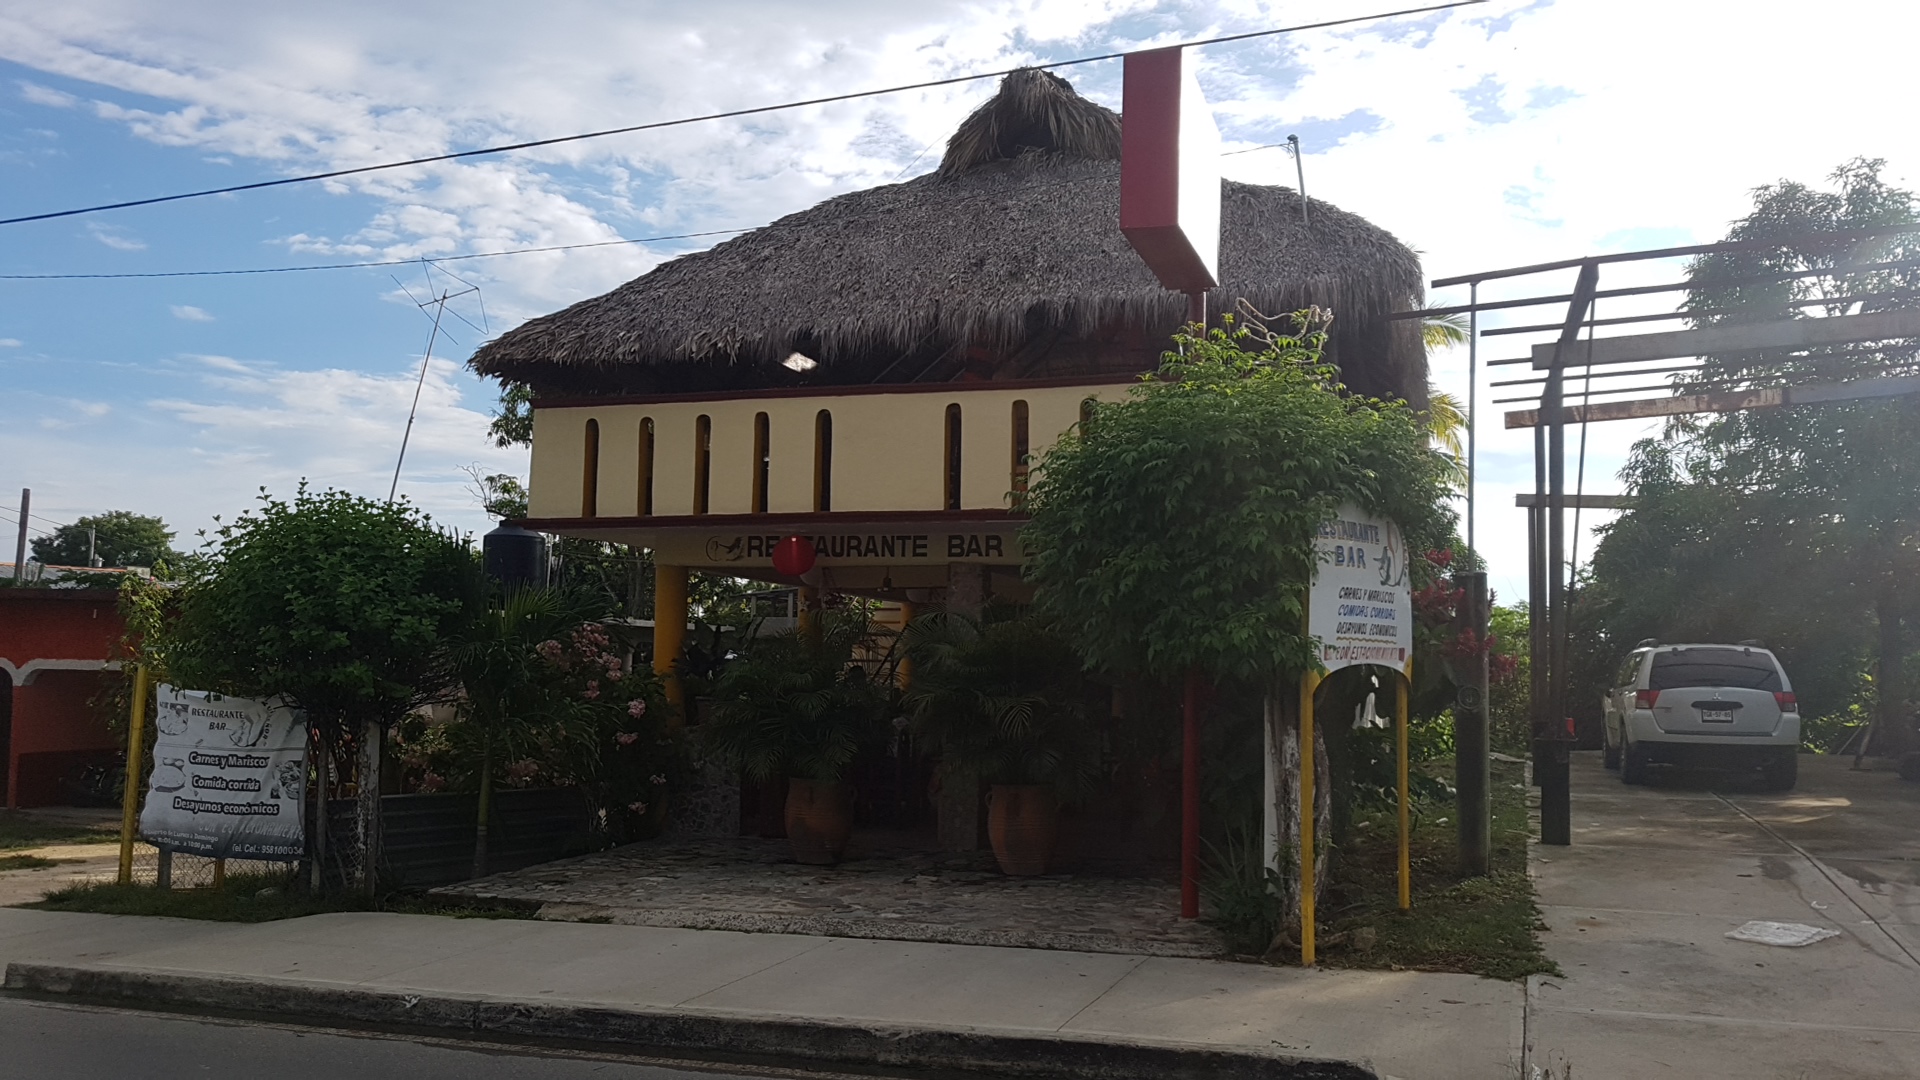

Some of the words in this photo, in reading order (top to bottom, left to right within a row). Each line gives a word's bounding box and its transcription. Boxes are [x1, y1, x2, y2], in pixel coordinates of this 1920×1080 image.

[747, 535, 928, 558] REAURANTE
[947, 534, 1004, 558] BAR
[1335, 545, 1366, 569] BAR
[1339, 586, 1363, 601] CARNES
[1363, 589, 1368, 601] Y
[1367, 589, 1396, 604] MARISCOS
[1338, 604, 1369, 618] COMIDAS
[1370, 607, 1397, 621] CORRIDAS
[1336, 622, 1368, 635] DESAYUNOS
[191, 707, 245, 719] RESTAURANTE
[208, 721, 227, 731] BAR
[190, 752, 220, 765] Carnes
[221, 757, 228, 768] y
[192, 776, 226, 789] Comida
[227, 778, 260, 791] corrida
[174, 797, 222, 813] Desayunos
[223, 803, 279, 815] económicos
[194, 833, 219, 843] Domingo
[222, 821, 304, 840] ESACIONAMIENTO
